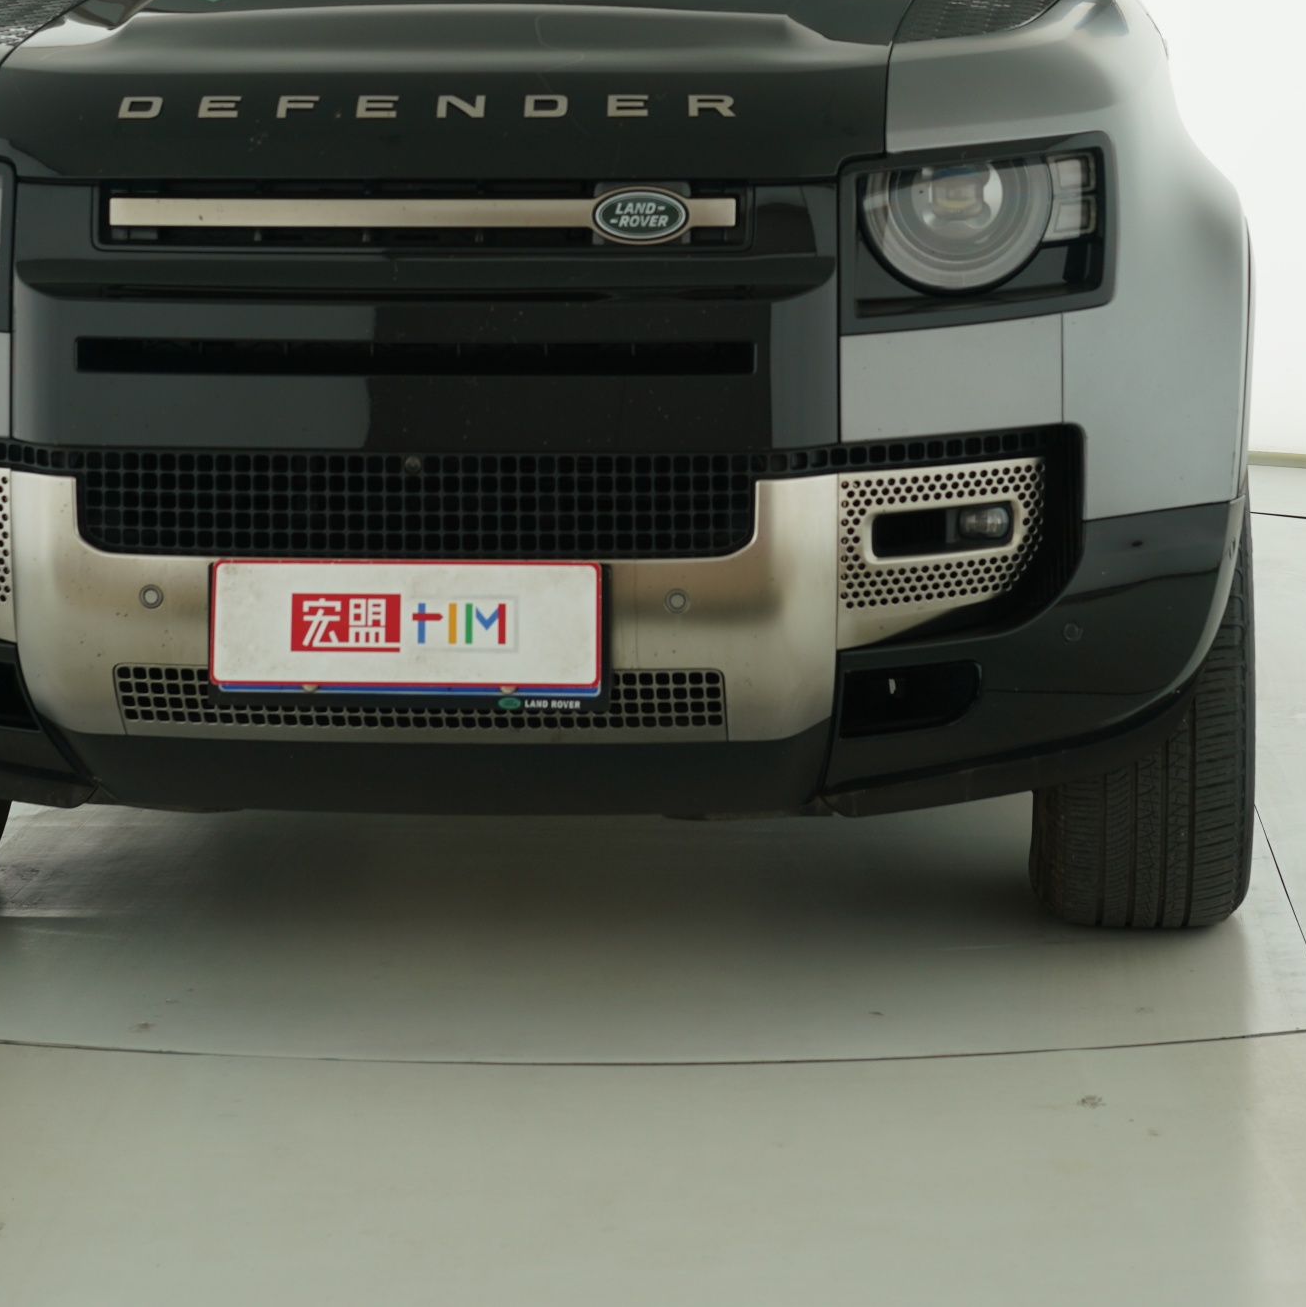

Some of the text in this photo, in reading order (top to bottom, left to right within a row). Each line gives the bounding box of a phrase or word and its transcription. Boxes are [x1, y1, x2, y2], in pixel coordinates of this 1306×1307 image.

[117, 94, 737, 119] DEFENDER
[302, 598, 401, 648] 宏盟
[524, 699, 549, 709] LAND
[551, 700, 581, 710] ROVER
